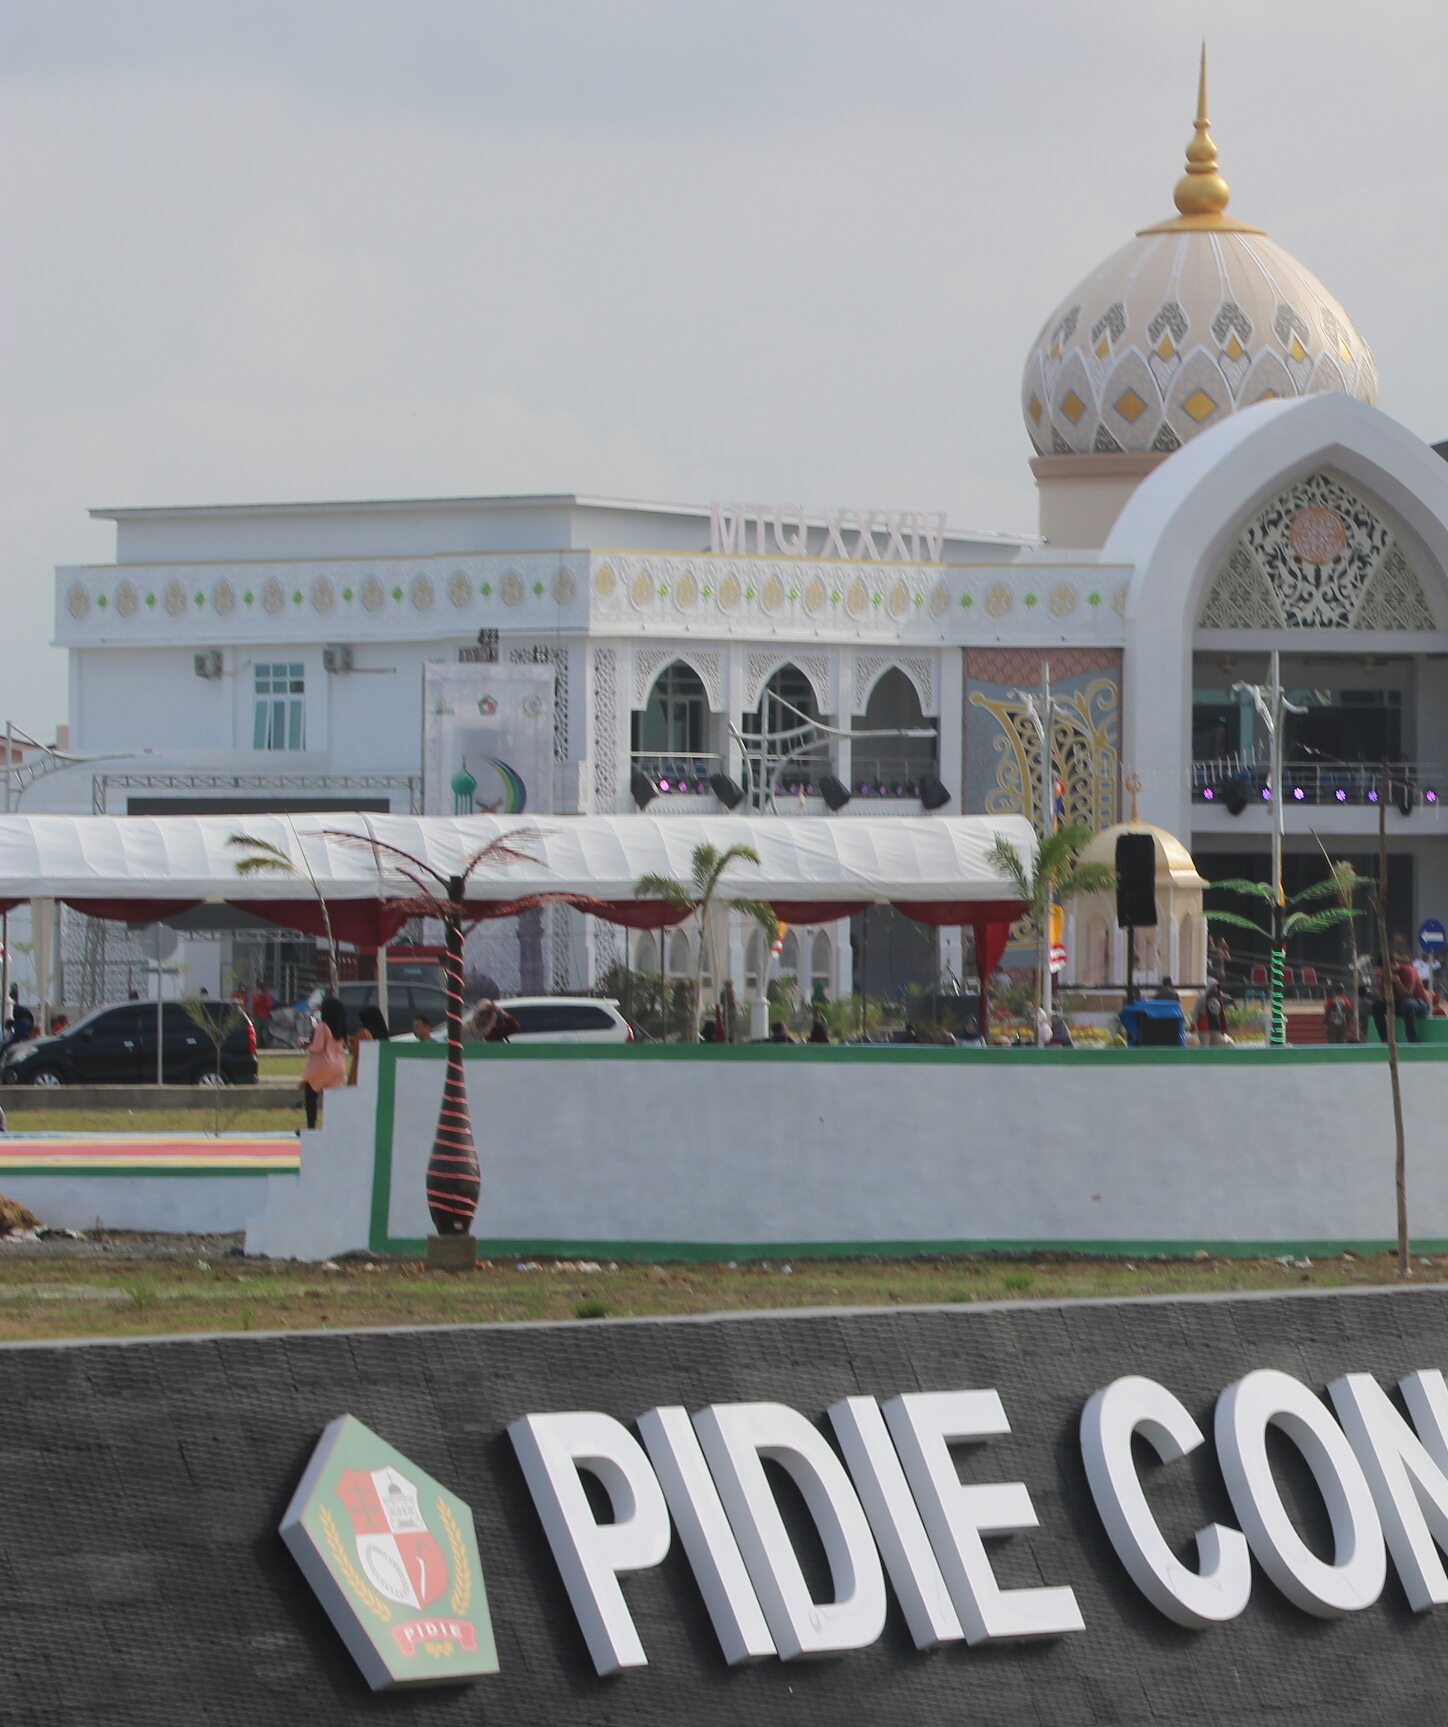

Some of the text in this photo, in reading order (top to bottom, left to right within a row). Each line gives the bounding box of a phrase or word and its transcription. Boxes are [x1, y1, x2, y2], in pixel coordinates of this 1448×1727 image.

[710, 502, 947, 563] MTQ XXXIV
[506, 1388, 1087, 1677] PIDIE
[403, 1621, 463, 1643] PIDIE
